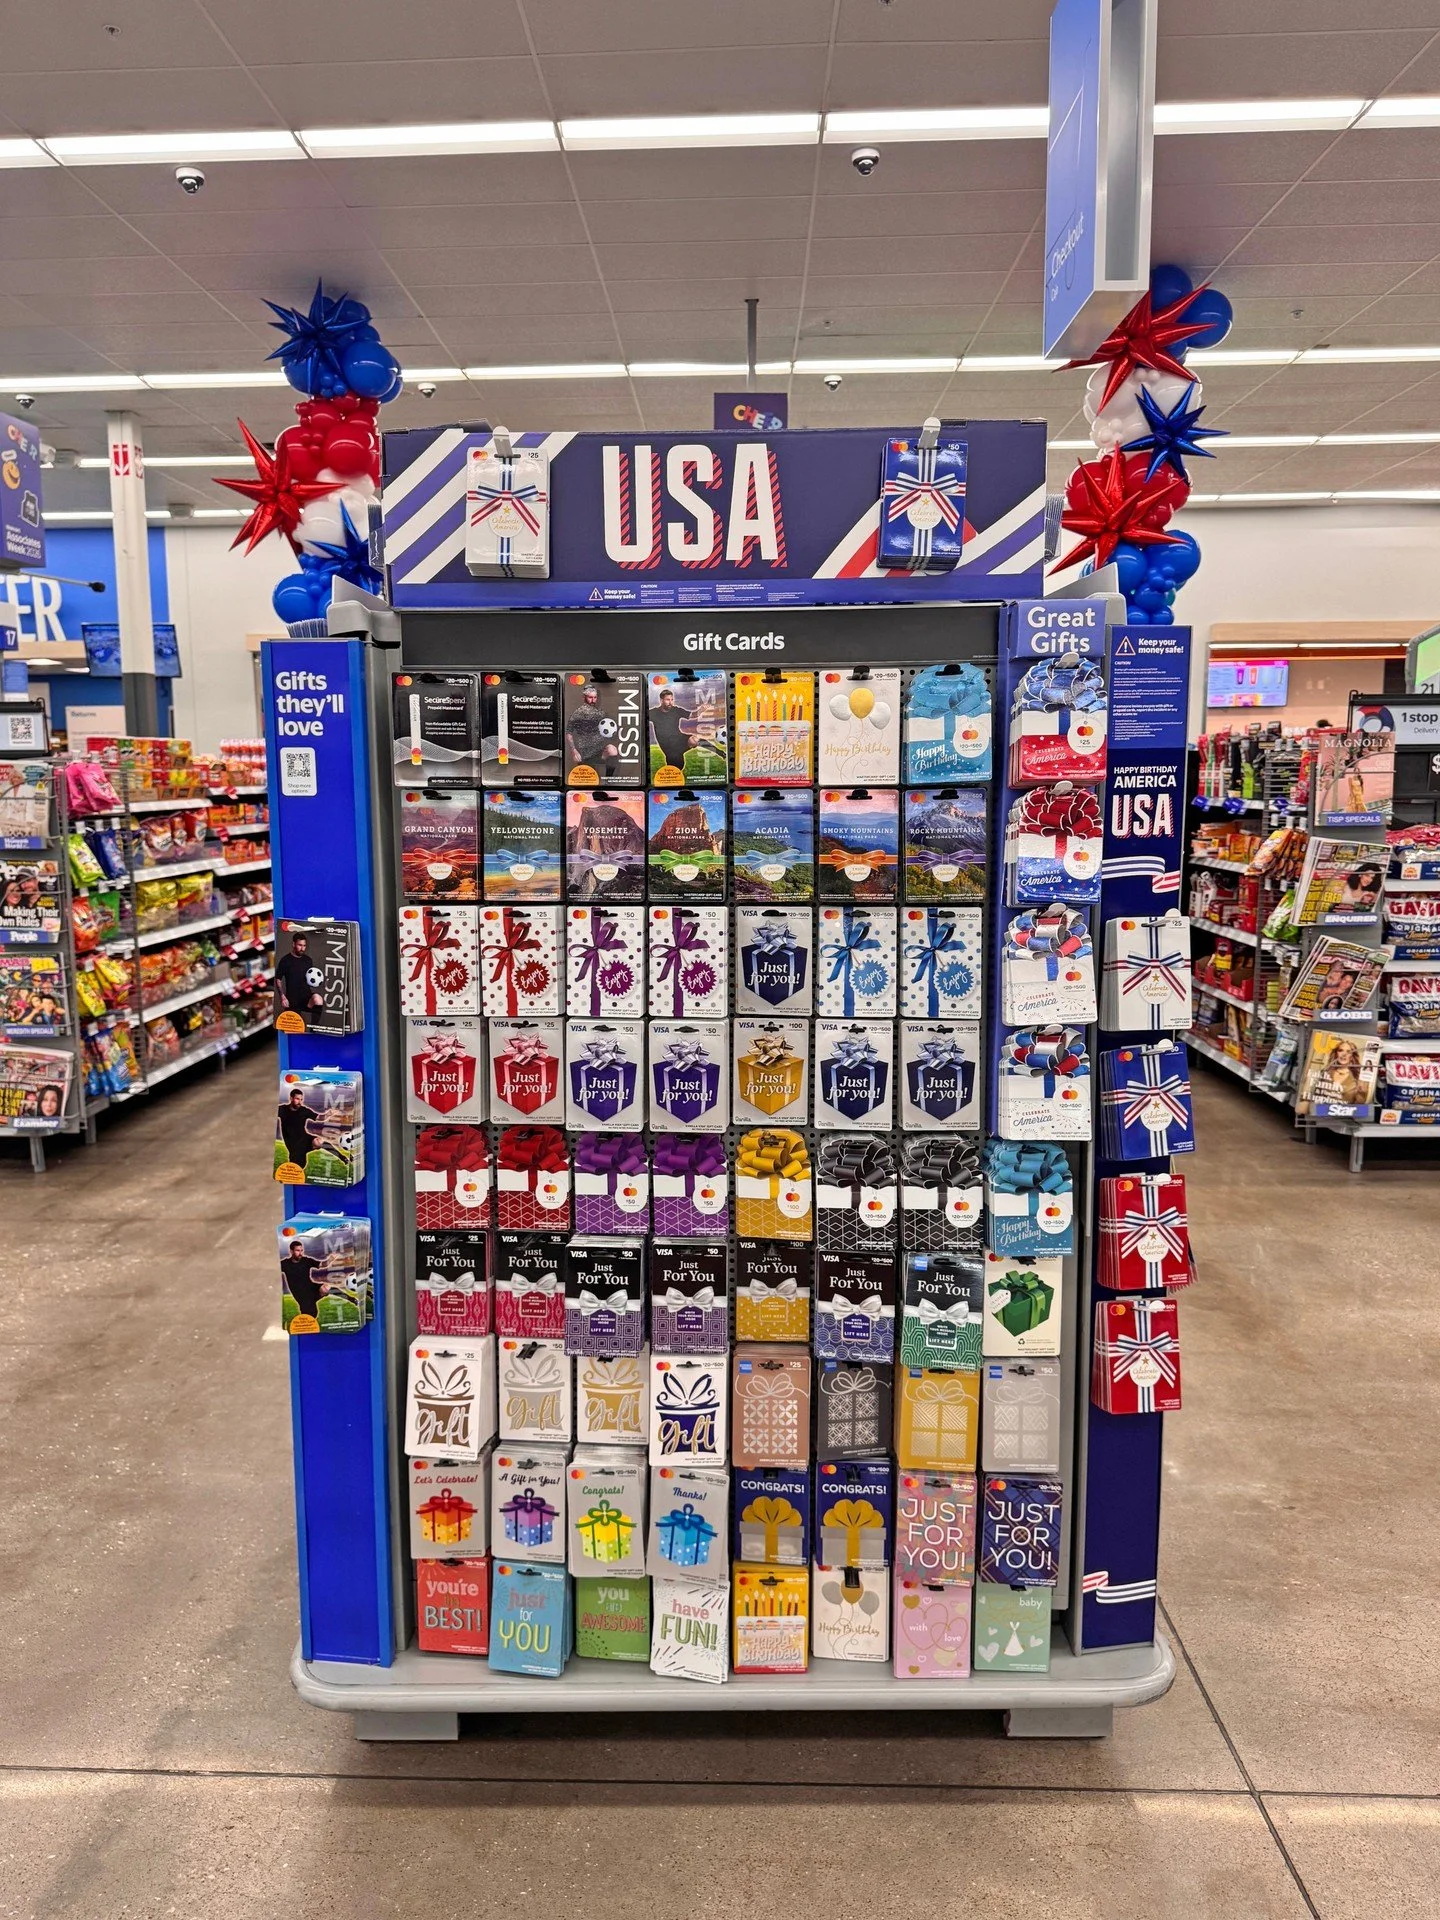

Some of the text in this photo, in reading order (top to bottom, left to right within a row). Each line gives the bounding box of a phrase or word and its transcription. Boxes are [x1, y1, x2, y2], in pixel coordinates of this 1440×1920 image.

[1051, 211, 1084, 278] Checkout
[602, 443, 780, 564] USA
[1027, 606, 1096, 628] Great
[5, 629, 17, 646] 17
[683, 631, 785, 651] Gift Cards
[1030, 631, 1090, 654] Gifts
[1138, 638, 1177, 647] Keep your
[1138, 646, 1184, 655] money safe!
[275, 671, 328, 691] Gifts
[1420, 683, 1435, 695] 21
[276, 694, 345, 717] they'll
[277, 717, 324, 736] love
[617, 688, 640, 764] MESSI
[1324, 738, 1393, 748] MAGNOLIA
[911, 743, 946, 763] Happy
[1025, 752, 1068, 766] America
[914, 752, 960, 772] Birthday
[1114, 765, 1178, 774] HAPPY BIRTHDAY
[1114, 775, 1177, 789] AMERICA
[1111, 793, 1173, 838] USA
[436, 826, 474, 834] CANYON
[490, 827, 555, 835] YELLOWSTONE
[754, 826, 790, 834] ACADIA
[909, 827, 935, 835] ROCKY
[4, 906, 60, 918] Making Their
[741, 910, 758, 918] VISA
[15, 915, 41, 928] Rules
[1171, 919, 1183, 927] $25
[1324, 915, 1378, 924] ENQUIRER
[10, 931, 38, 943] People
[760, 962, 789, 973] Just
[324, 940, 347, 1015] MESSI
[439, 966, 464, 987] Enjoy
[520, 966, 545, 988] Enjoy
[604, 967, 628, 990] Enjoy
[687, 968, 711, 990] Enjoy
[748, 972, 801, 987] for you!
[857, 969, 883, 989] Enjoy
[942, 970, 968, 991] Enjoy
[1017, 997, 1058, 1012] America
[1319, 1011, 1373, 1020] GLOBE
[410, 1019, 429, 1027] VISA
[737, 1022, 755, 1030] VISA
[820, 1024, 838, 1032] VISA
[429, 1070, 458, 1084] Just
[756, 1073, 784, 1084] Just
[839, 1076, 868, 1088] Just
[418, 1080, 469, 1096] for you!
[744, 1082, 797, 1097] for you!
[826, 1087, 881, 1101] for you!
[1327, 1104, 1358, 1117] Star
[12, 1118, 59, 1128] Examiner
[1013, 1114, 1054, 1127] America
[997, 1219, 1031, 1234] Happy
[999, 1228, 1042, 1246] Birthday
[441, 1248, 460, 1256] Just
[570, 1250, 588, 1258] VISA
[656, 1248, 673, 1256] VISA
[822, 1254, 840, 1263] VISA
[426, 1256, 476, 1268] For You
[592, 1263, 613, 1273] Just
[678, 1260, 699, 1270] Just
[576, 1272, 630, 1285] For You
[662, 1270, 716, 1282] For You
[845, 1267, 866, 1277] Just
[933, 1271, 955, 1283] Just
[829, 1276, 883, 1291] For You
[916, 1280, 971, 1298] For You
[413, 1474, 478, 1484] Let's Celebrate!
[498, 1473, 561, 1487] A Gift for You!
[581, 1484, 625, 1497] Congrats!
[672, 1486, 707, 1501] Thanks!
[740, 1480, 805, 1494] CONGRATS!
[901, 1498, 973, 1524] JUST
[988, 1500, 1060, 1524] JUST
[907, 1522, 964, 1548] FOR
[994, 1524, 1050, 1547] FOR
[903, 1545, 966, 1572] YOU!
[989, 1546, 1052, 1571] YOU!
[426, 1579, 479, 1598] you're
[597, 1586, 630, 1604] you
[507, 1588, 548, 1611] just
[1019, 1597, 1043, 1610] baby
[519, 1608, 534, 1621] for
[672, 1599, 710, 1620] have
[424, 1605, 482, 1632] BEST!
[581, 1612, 647, 1633] AWESOME
[660, 1613, 718, 1651] FUN!
[909, 1624, 928, 1632] with
[499, 1619, 550, 1654] YOU
[944, 1633, 962, 1642] love
